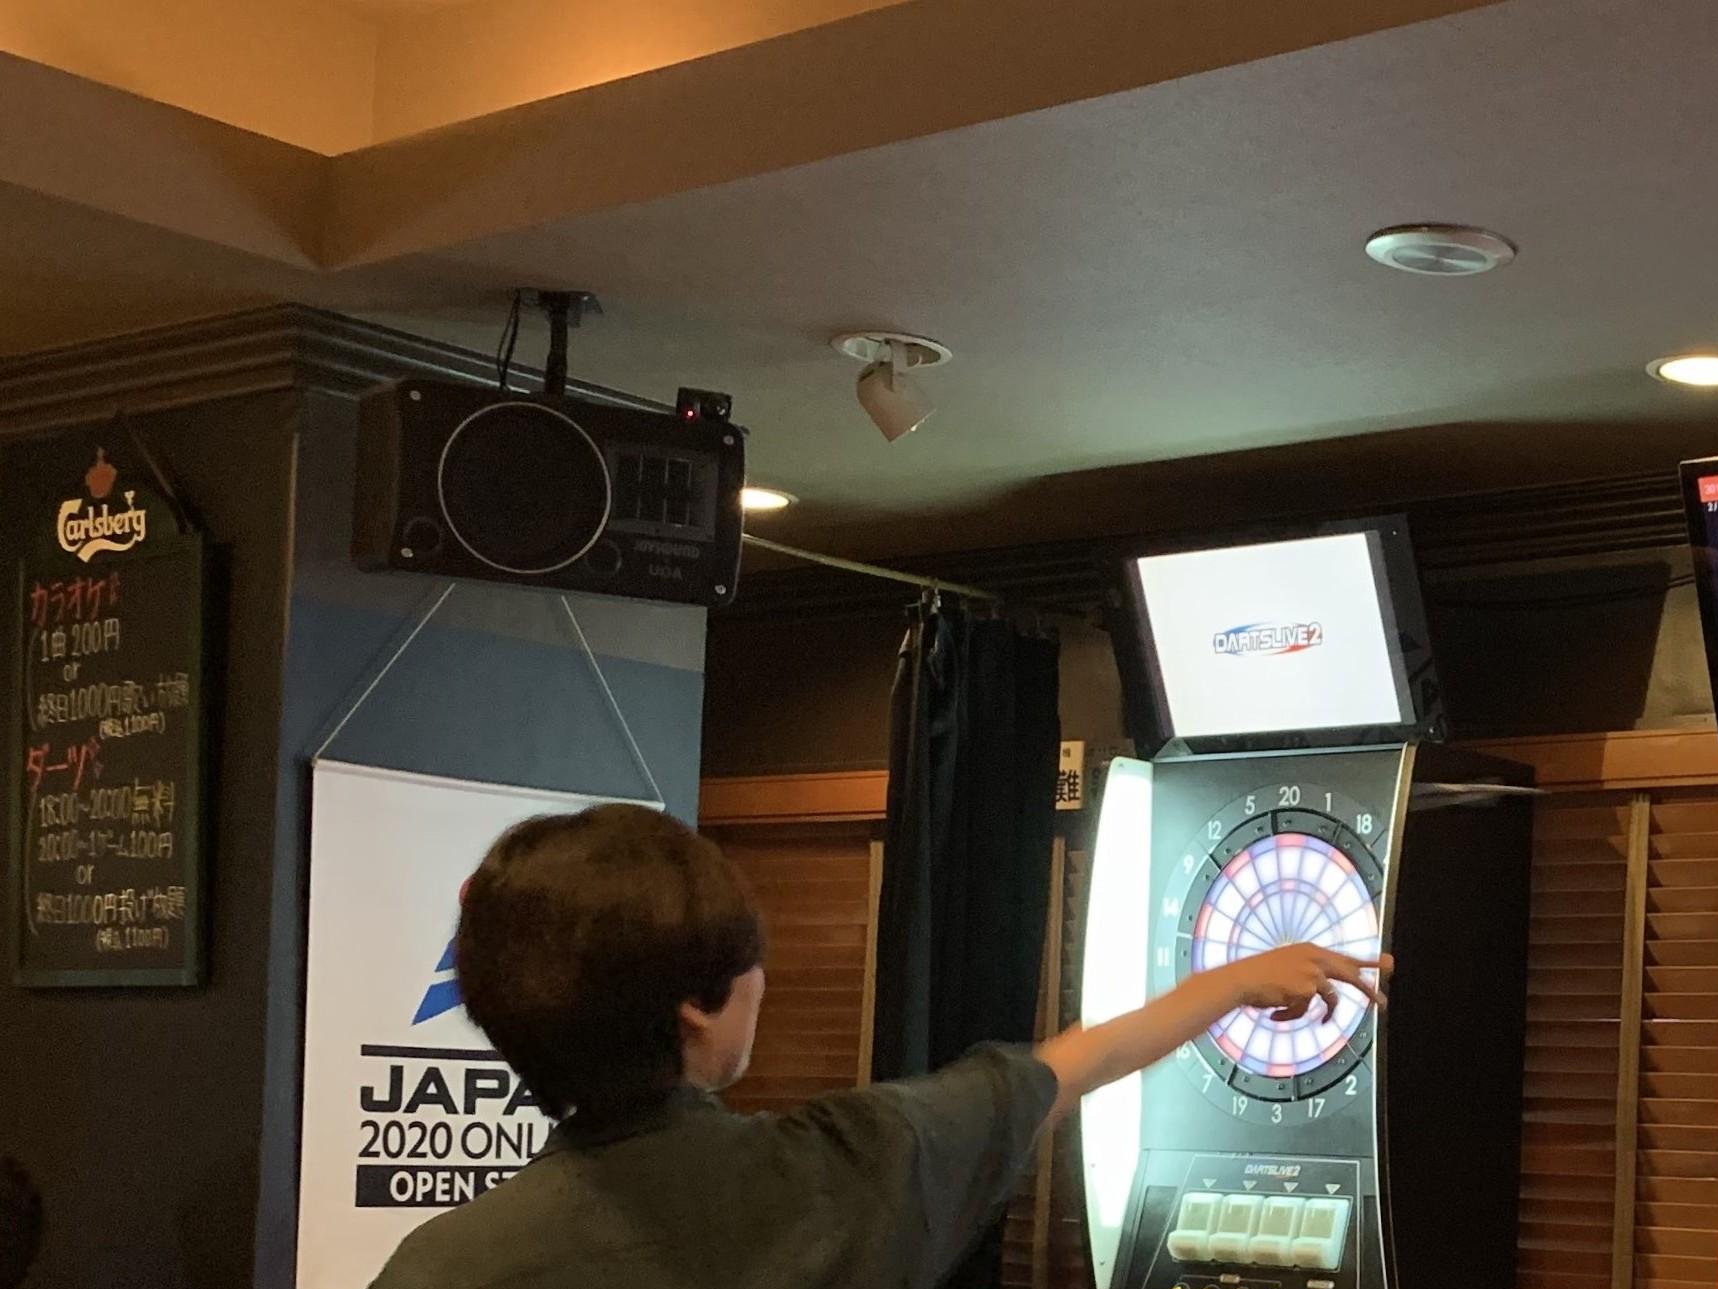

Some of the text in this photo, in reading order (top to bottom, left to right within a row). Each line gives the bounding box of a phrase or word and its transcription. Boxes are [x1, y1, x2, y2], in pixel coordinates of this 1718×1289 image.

[57, 490, 147, 563] Carlsberg
[1213, 622, 1324, 655] DARTSLIVE2
[1244, 796, 1256, 815] 5
[1278, 785, 1301, 806] 20
[1324, 792, 1333, 812] 1
[1207, 820, 1222, 840] 12
[1355, 814, 1373, 834] 18
[1183, 855, 1195, 874] 9
[1201, 1074, 1214, 1093] 7
[1344, 1074, 1358, 1096] 2
[1232, 1096, 1249, 1116] 19
[1270, 1103, 1283, 1124] 3
[1307, 1098, 1326, 1119] 17
[358, 1120, 453, 1160] 2020
[389, 1170, 475, 1202] OPEN
